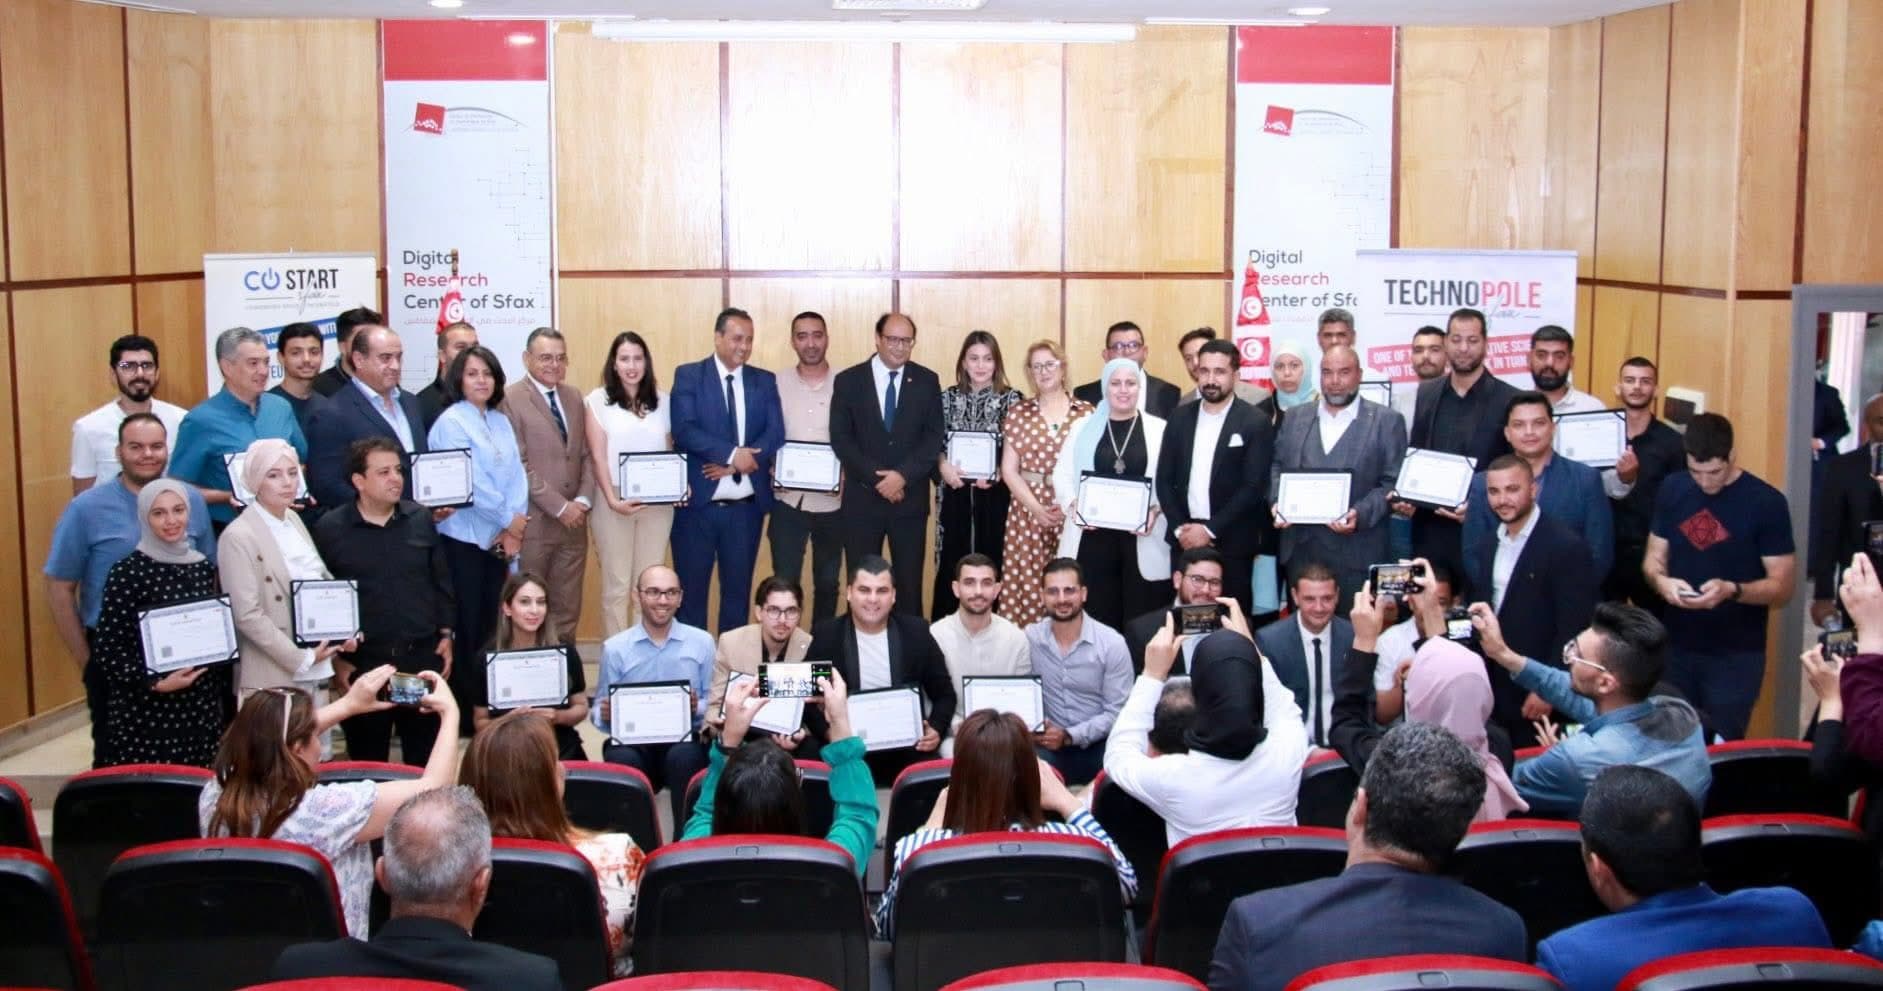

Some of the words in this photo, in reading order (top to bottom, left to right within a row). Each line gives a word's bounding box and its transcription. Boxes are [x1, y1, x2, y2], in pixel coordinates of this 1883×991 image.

[403, 250, 455, 270] Digita
[1249, 250, 1303, 269] Digital
[286, 268, 339, 290] START
[1260, 272, 1330, 286] esearch
[470, 294, 489, 309] of
[493, 294, 535, 309] Sfax
[1262, 293, 1307, 308] enter
[1312, 293, 1327, 307] of
[1383, 279, 1542, 308] TECHNOPOLE
